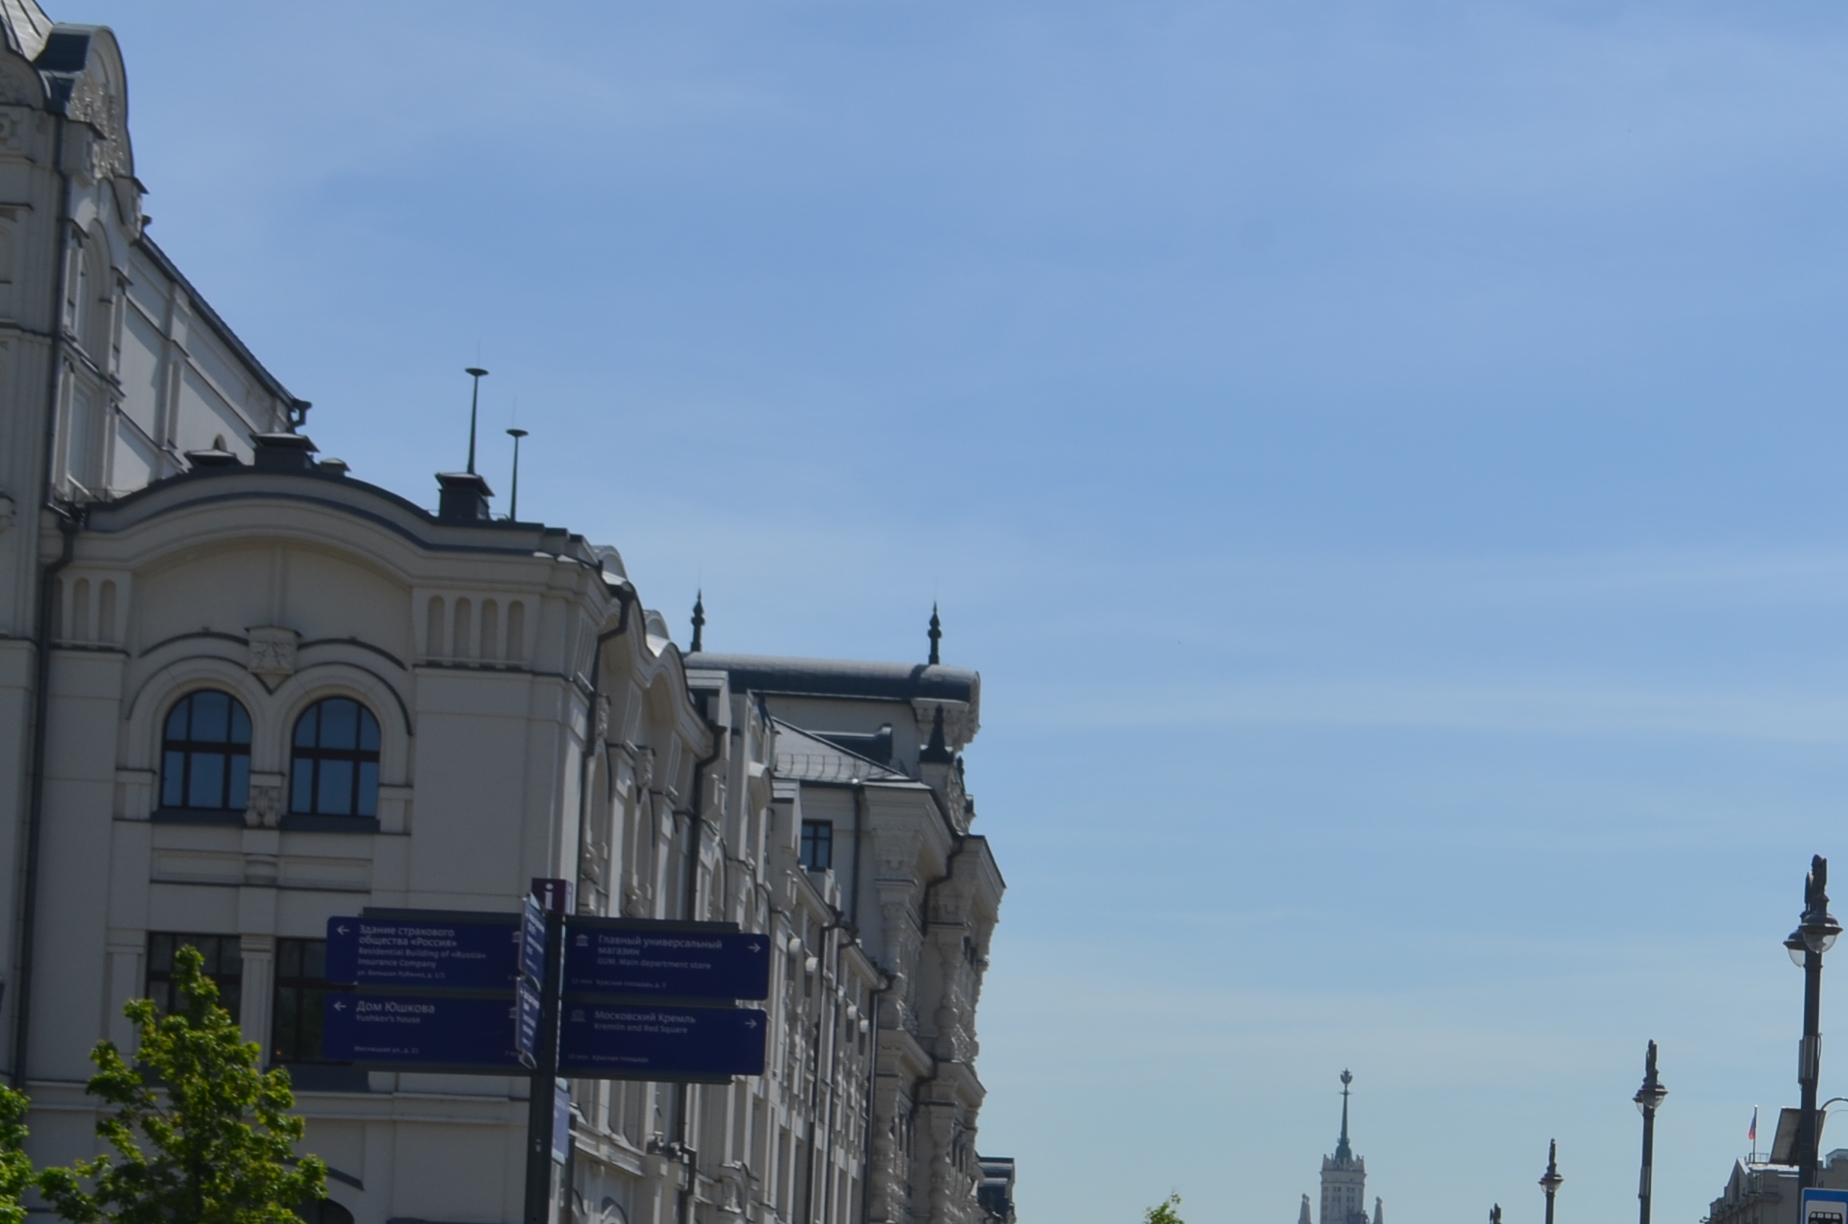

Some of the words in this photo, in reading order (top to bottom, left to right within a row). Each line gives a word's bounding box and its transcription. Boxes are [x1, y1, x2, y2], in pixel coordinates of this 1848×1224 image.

[359, 924, 396, 936] Здание
[398, 926, 455, 938] страхового
[359, 935, 409, 946] общества
[410, 937, 458, 948] «Россия»
[597, 934, 642, 946] Главный
[643, 937, 723, 949] универсальный
[358, 947, 404, 957] Residential
[405, 949, 439, 959] Building
[440, 950, 450, 958] of
[597, 947, 640, 957] магазин
[357, 958, 397, 967] Insurance
[399, 959, 437, 970] Company
[619, 958, 639, 967] Main
[640, 959, 688, 970] department
[690, 962, 711, 970] store
[356, 1000, 382, 1013] Дом
[385, 1001, 435, 1014] Юшкова
[356, 1014, 395, 1023] Yushkov's
[396, 1015, 421, 1024] house
[594, 1010, 656, 1022] Московский
[658, 1013, 697, 1025] Кремль
[594, 1023, 626, 1032] Kremlin
[627, 1024, 642, 1032] and
[644, 1024, 659, 1033] Red
[660, 1025, 688, 1035] Square
